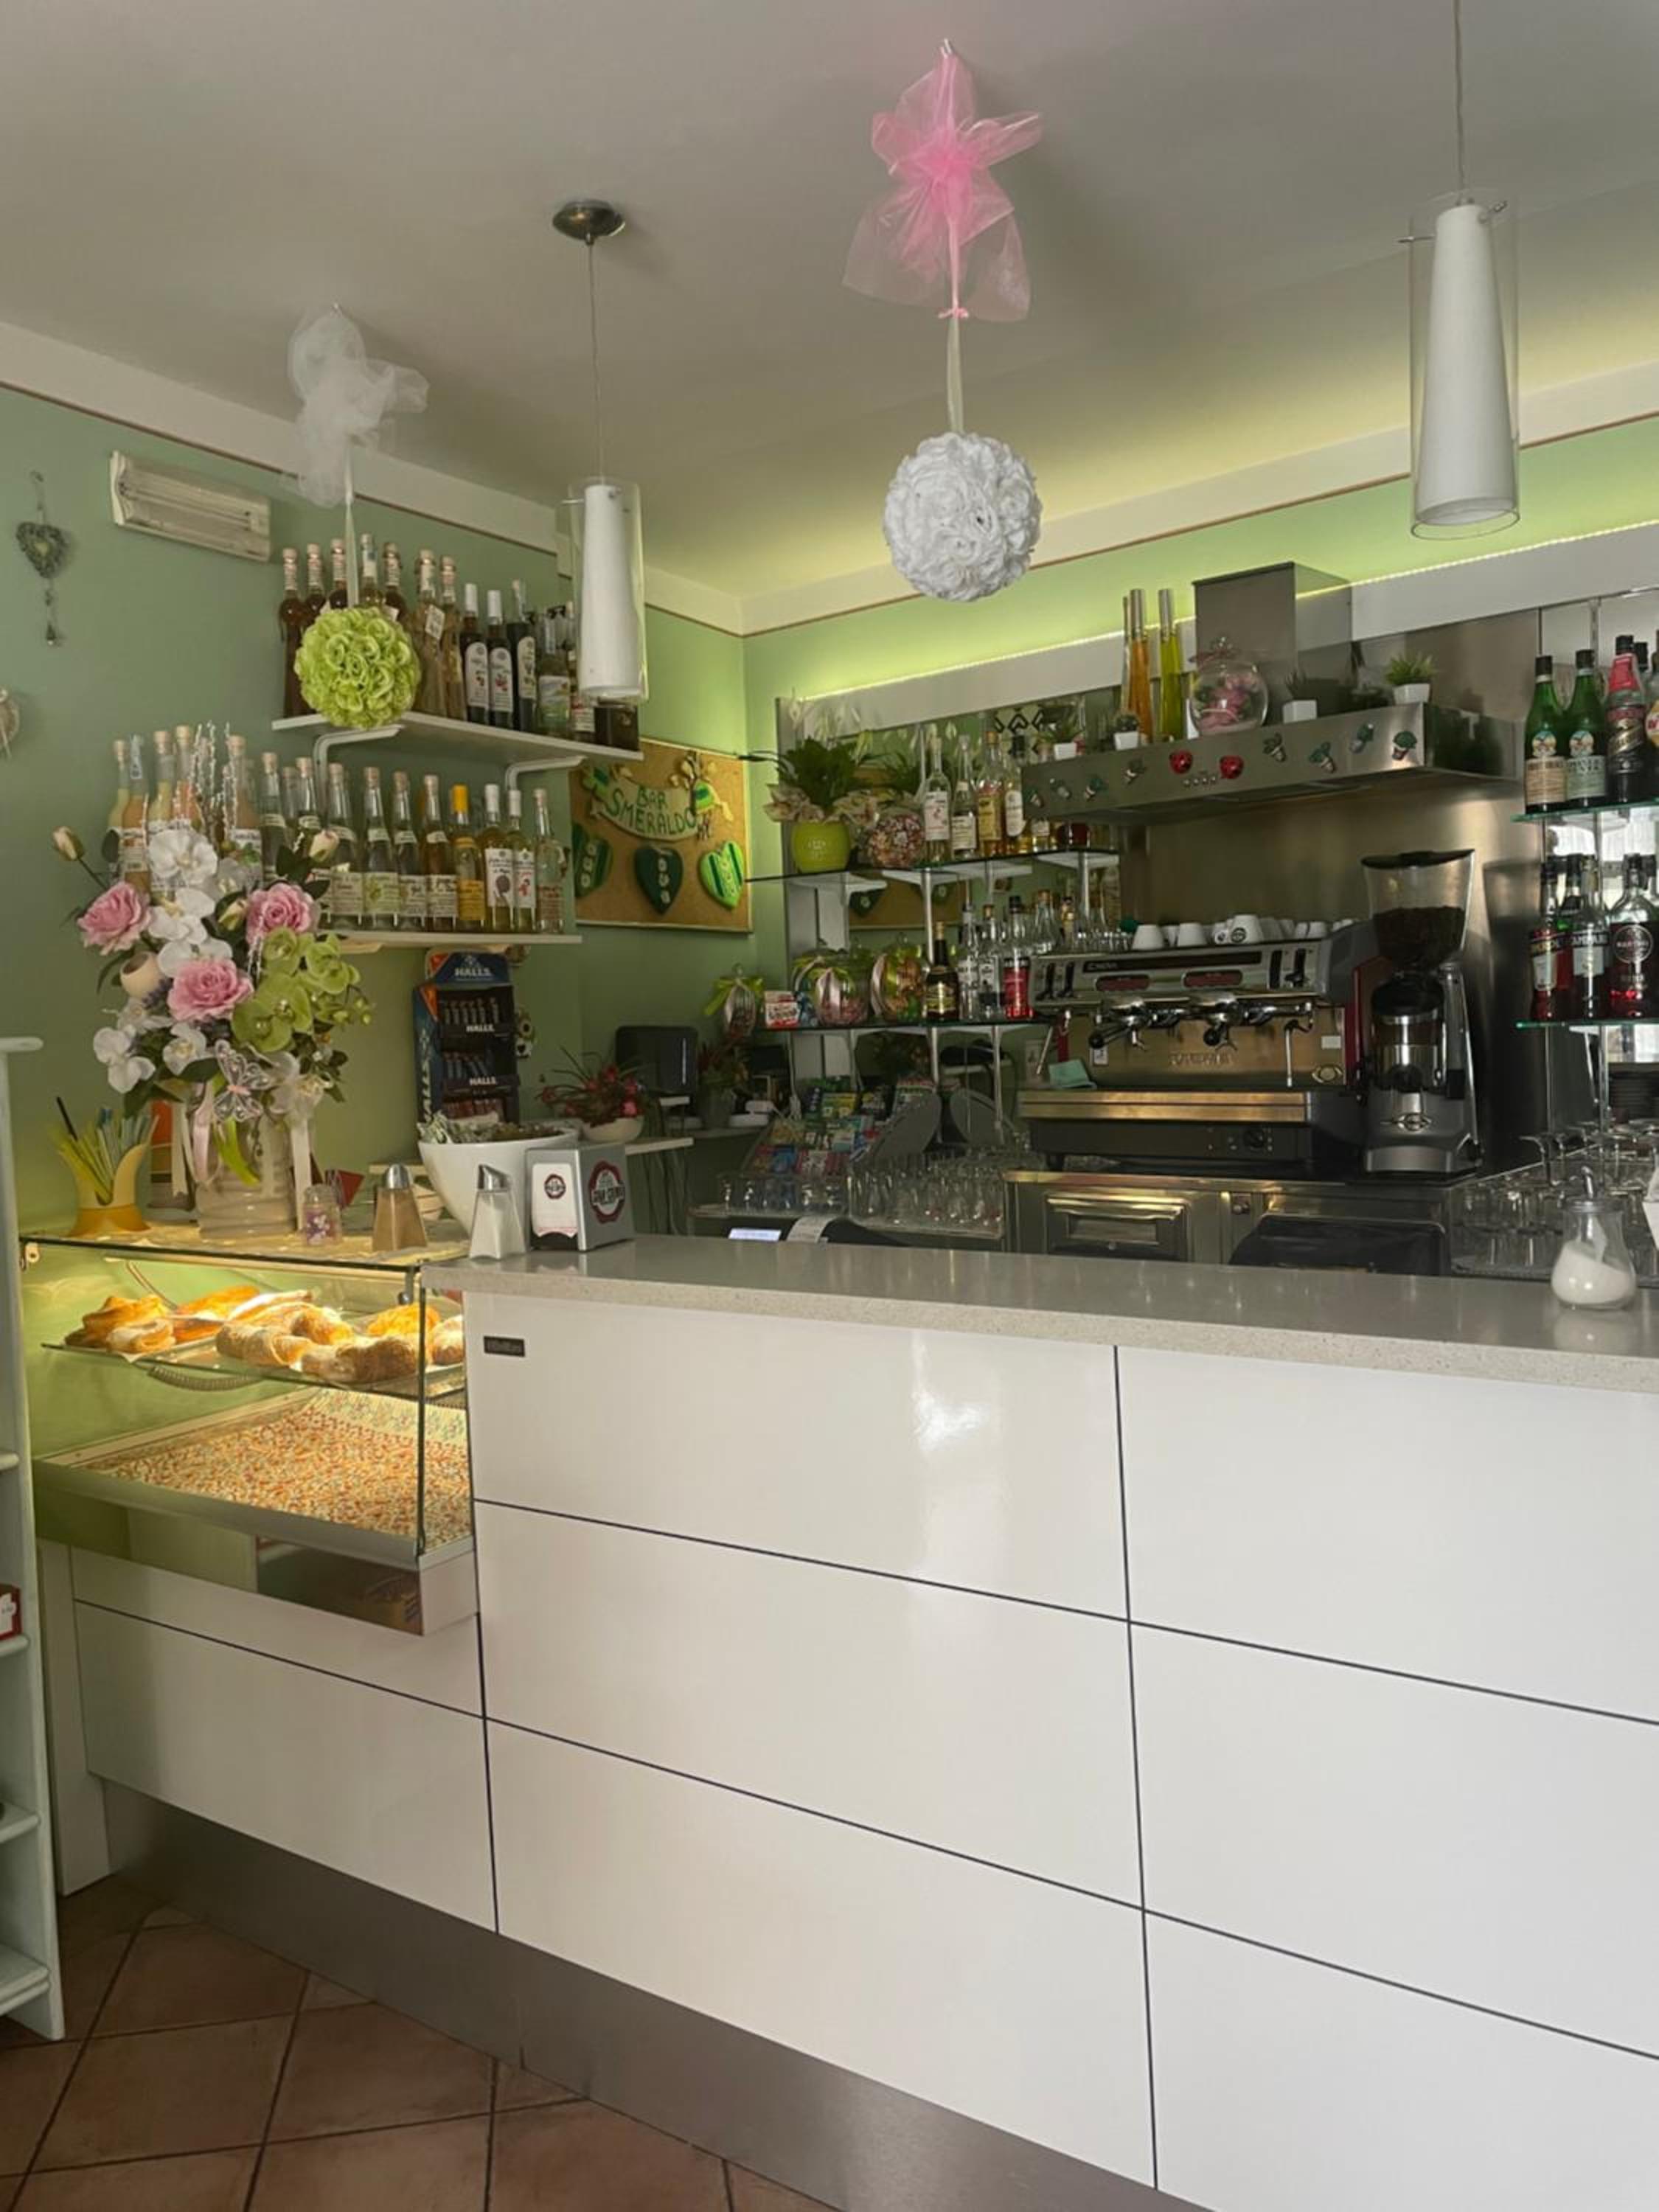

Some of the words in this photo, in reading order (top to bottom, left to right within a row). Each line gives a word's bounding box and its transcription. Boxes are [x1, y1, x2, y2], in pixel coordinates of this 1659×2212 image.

[605, 787, 697, 835] SMERALDO
[454, 967, 493, 977] HALLS
[466, 1023, 495, 1032] HALLS
[469, 1077, 498, 1085] HALLS
